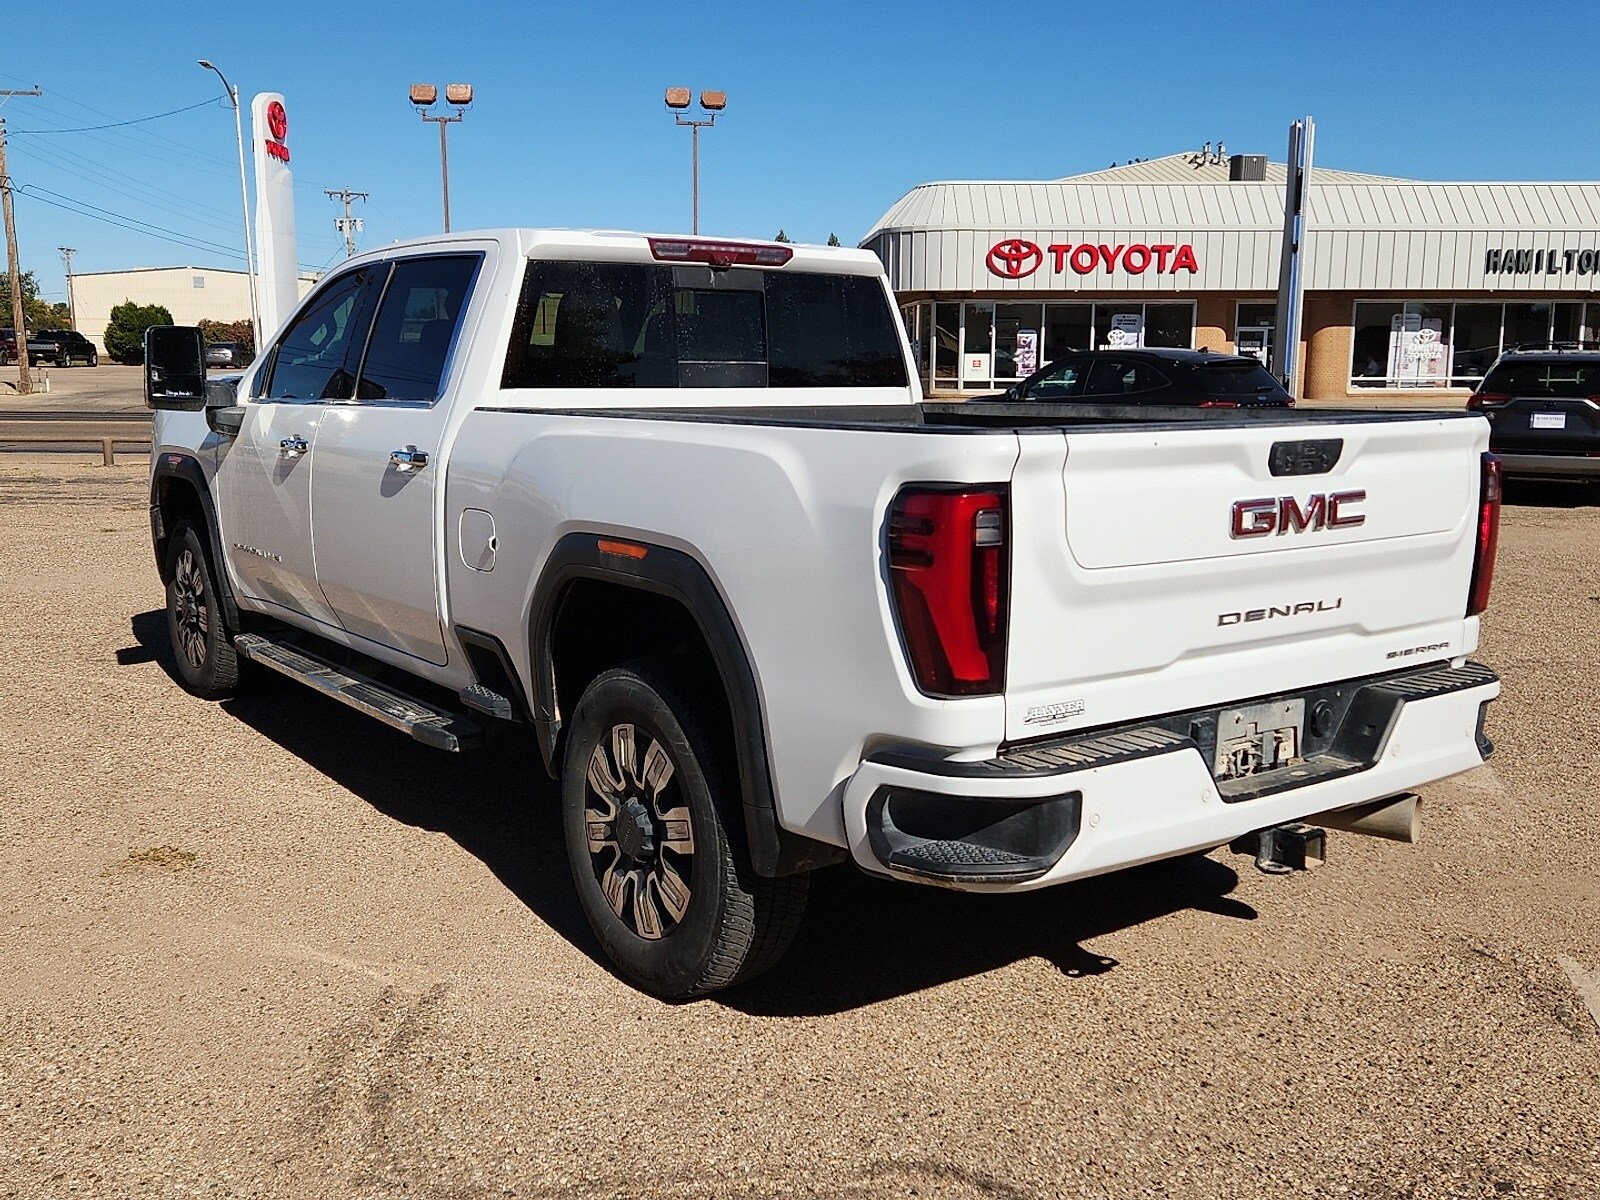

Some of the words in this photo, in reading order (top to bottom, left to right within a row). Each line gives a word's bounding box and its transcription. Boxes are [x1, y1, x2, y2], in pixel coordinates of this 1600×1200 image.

[1048, 244, 1199, 275] TOYOTA
[1229, 489, 1366, 540] GMC
[1217, 597, 1343, 627] DENALI
[1386, 641, 1450, 660] SIERRA
